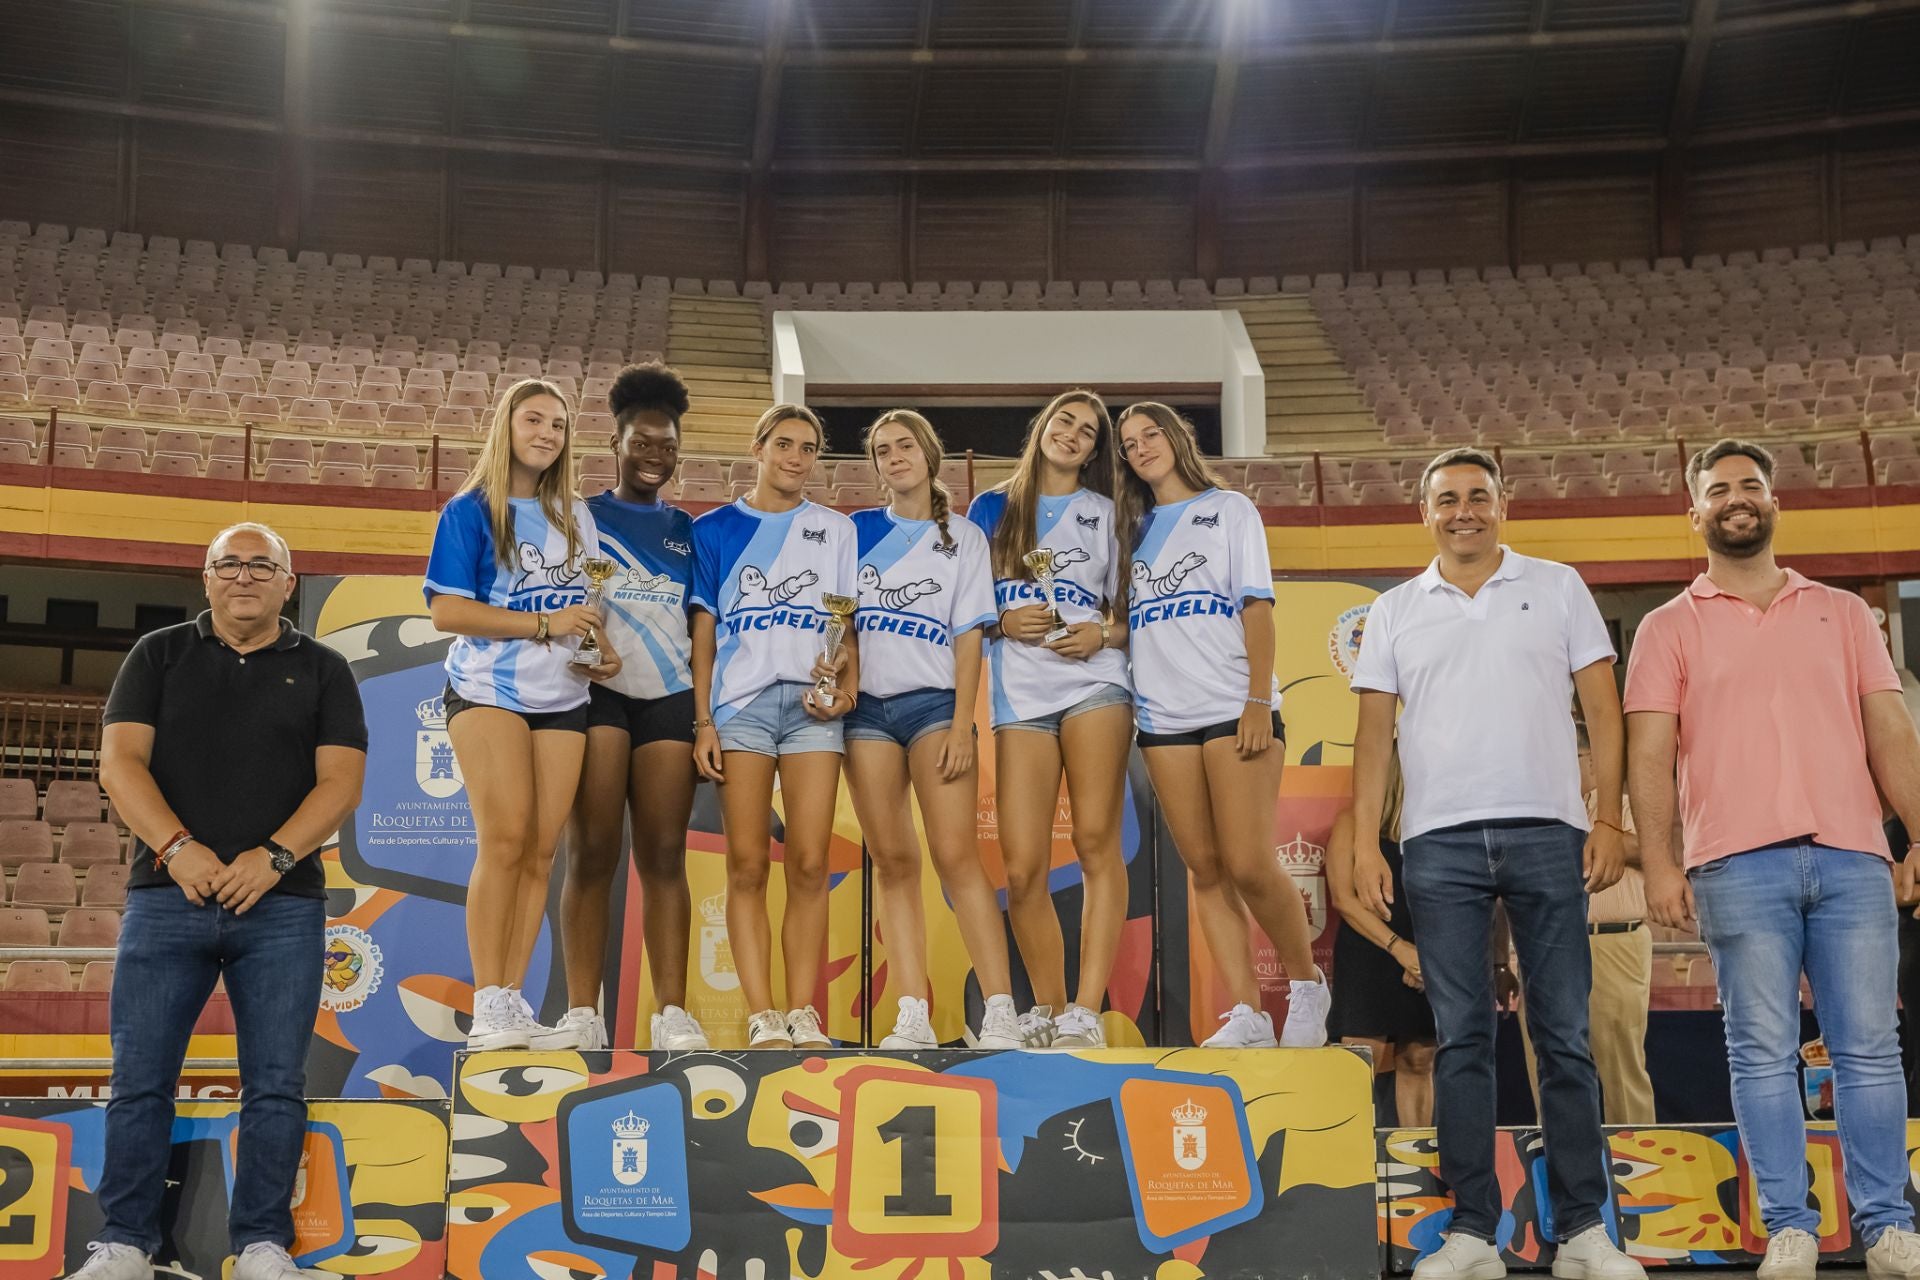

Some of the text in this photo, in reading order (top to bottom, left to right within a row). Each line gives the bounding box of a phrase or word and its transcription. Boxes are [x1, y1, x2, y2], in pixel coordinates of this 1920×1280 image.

[613, 591, 679, 605] MICHELIN
[726, 610, 827, 636] MICHELI
[395, 802, 472, 811] AYUNTAMIENTO
[372, 813, 468, 829] ROQUETAS DE
[386, 836, 396, 845] de
[432, 837, 459, 846] Cultura
[459, 839, 464, 847] y
[464, 837, 478, 845] Tie
[325, 926, 371, 944] QUETAS
[877, 1106, 952, 1216] 1
[1148, 1180, 1234, 1191] ROQUETAS DE MAR
[584, 1195, 675, 1206] ROQUETAS DE MAR
